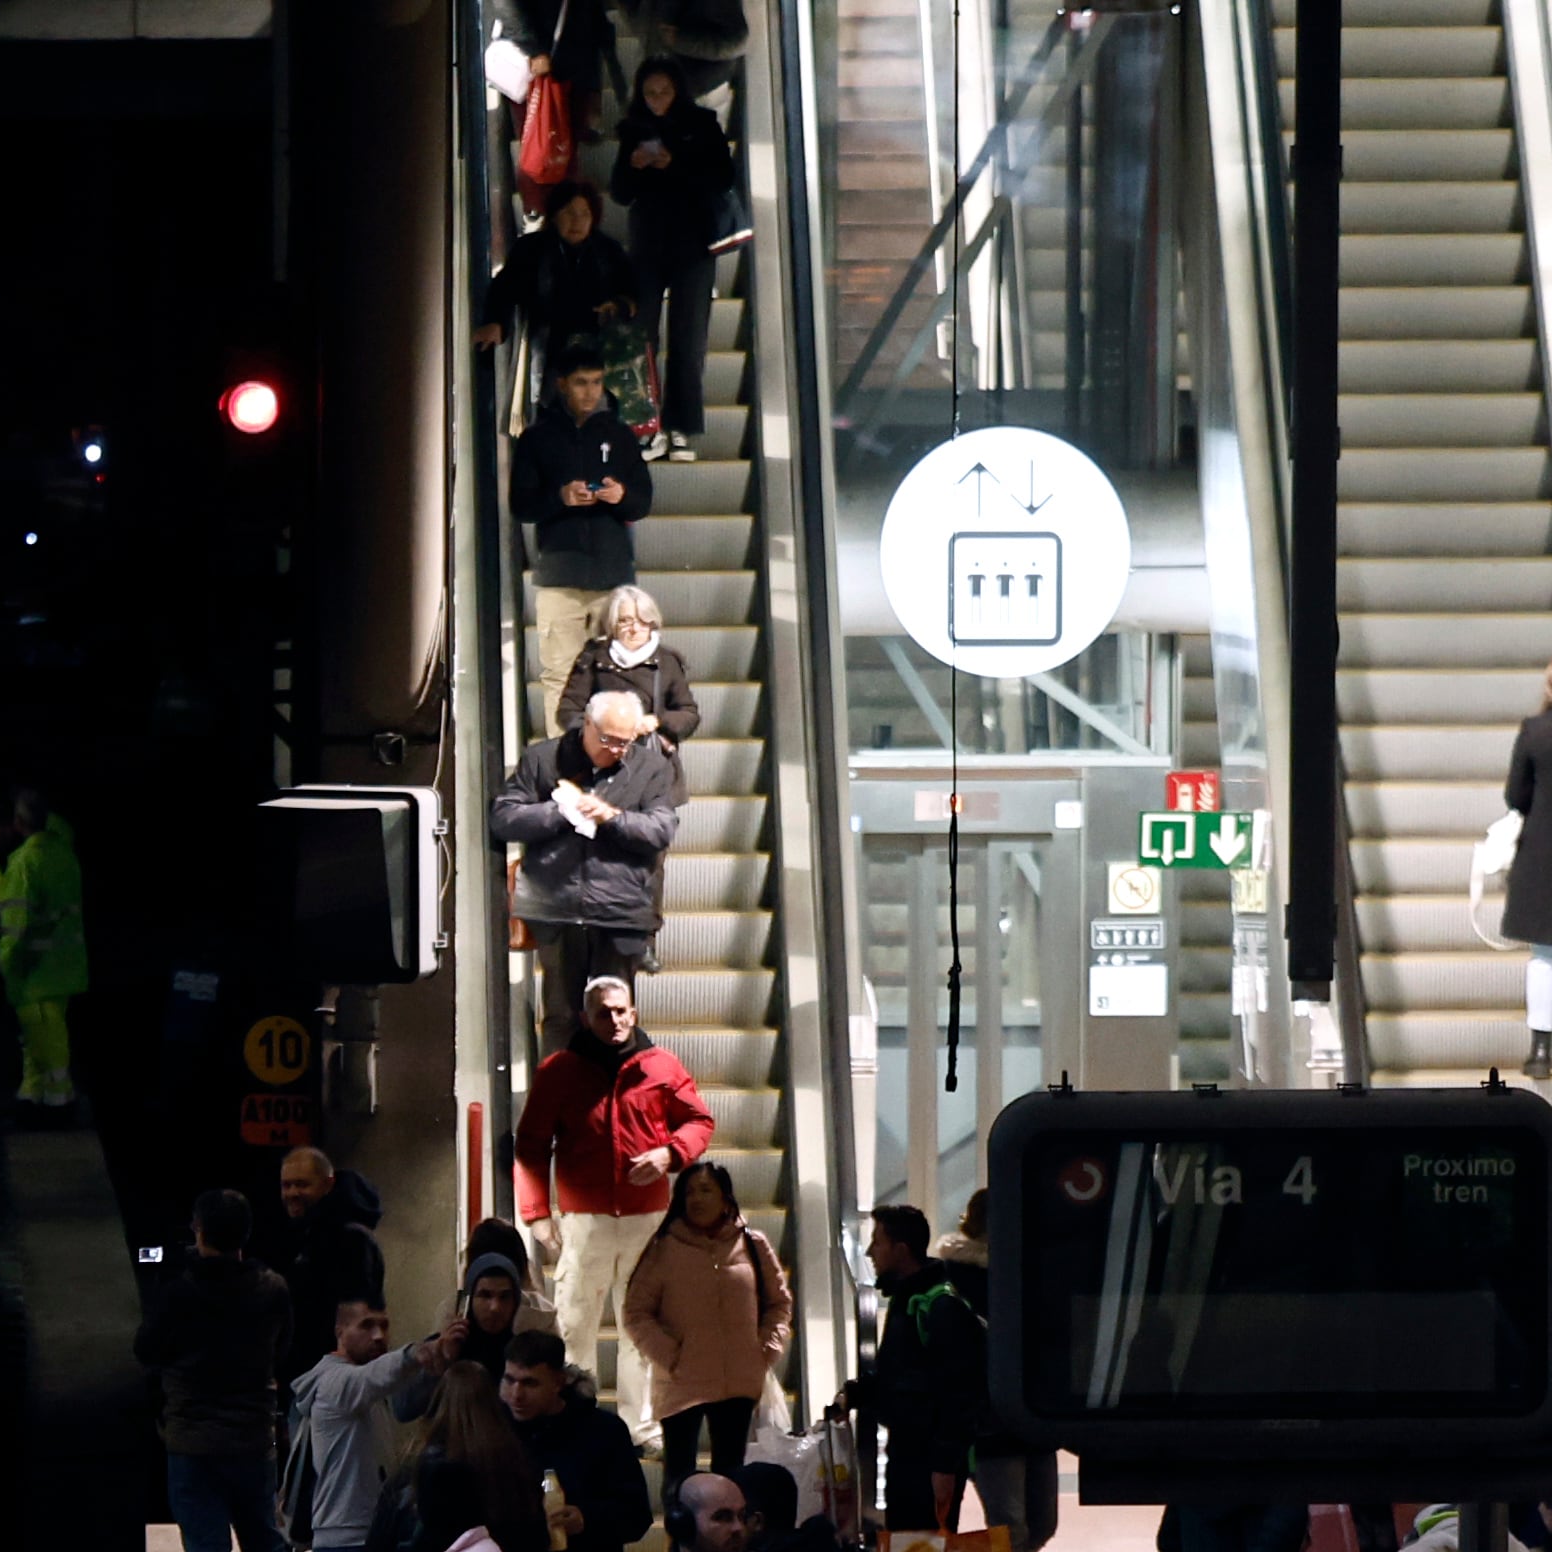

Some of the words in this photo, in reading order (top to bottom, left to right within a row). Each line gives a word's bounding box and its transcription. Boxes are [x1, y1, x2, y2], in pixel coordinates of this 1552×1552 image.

[259, 1030, 303, 1069] 10
[1153, 1152, 1245, 1206] Vía
[1281, 1154, 1319, 1206] 4
[1402, 1151, 1518, 1177] Próximo
[1432, 1180, 1489, 1204] tren
